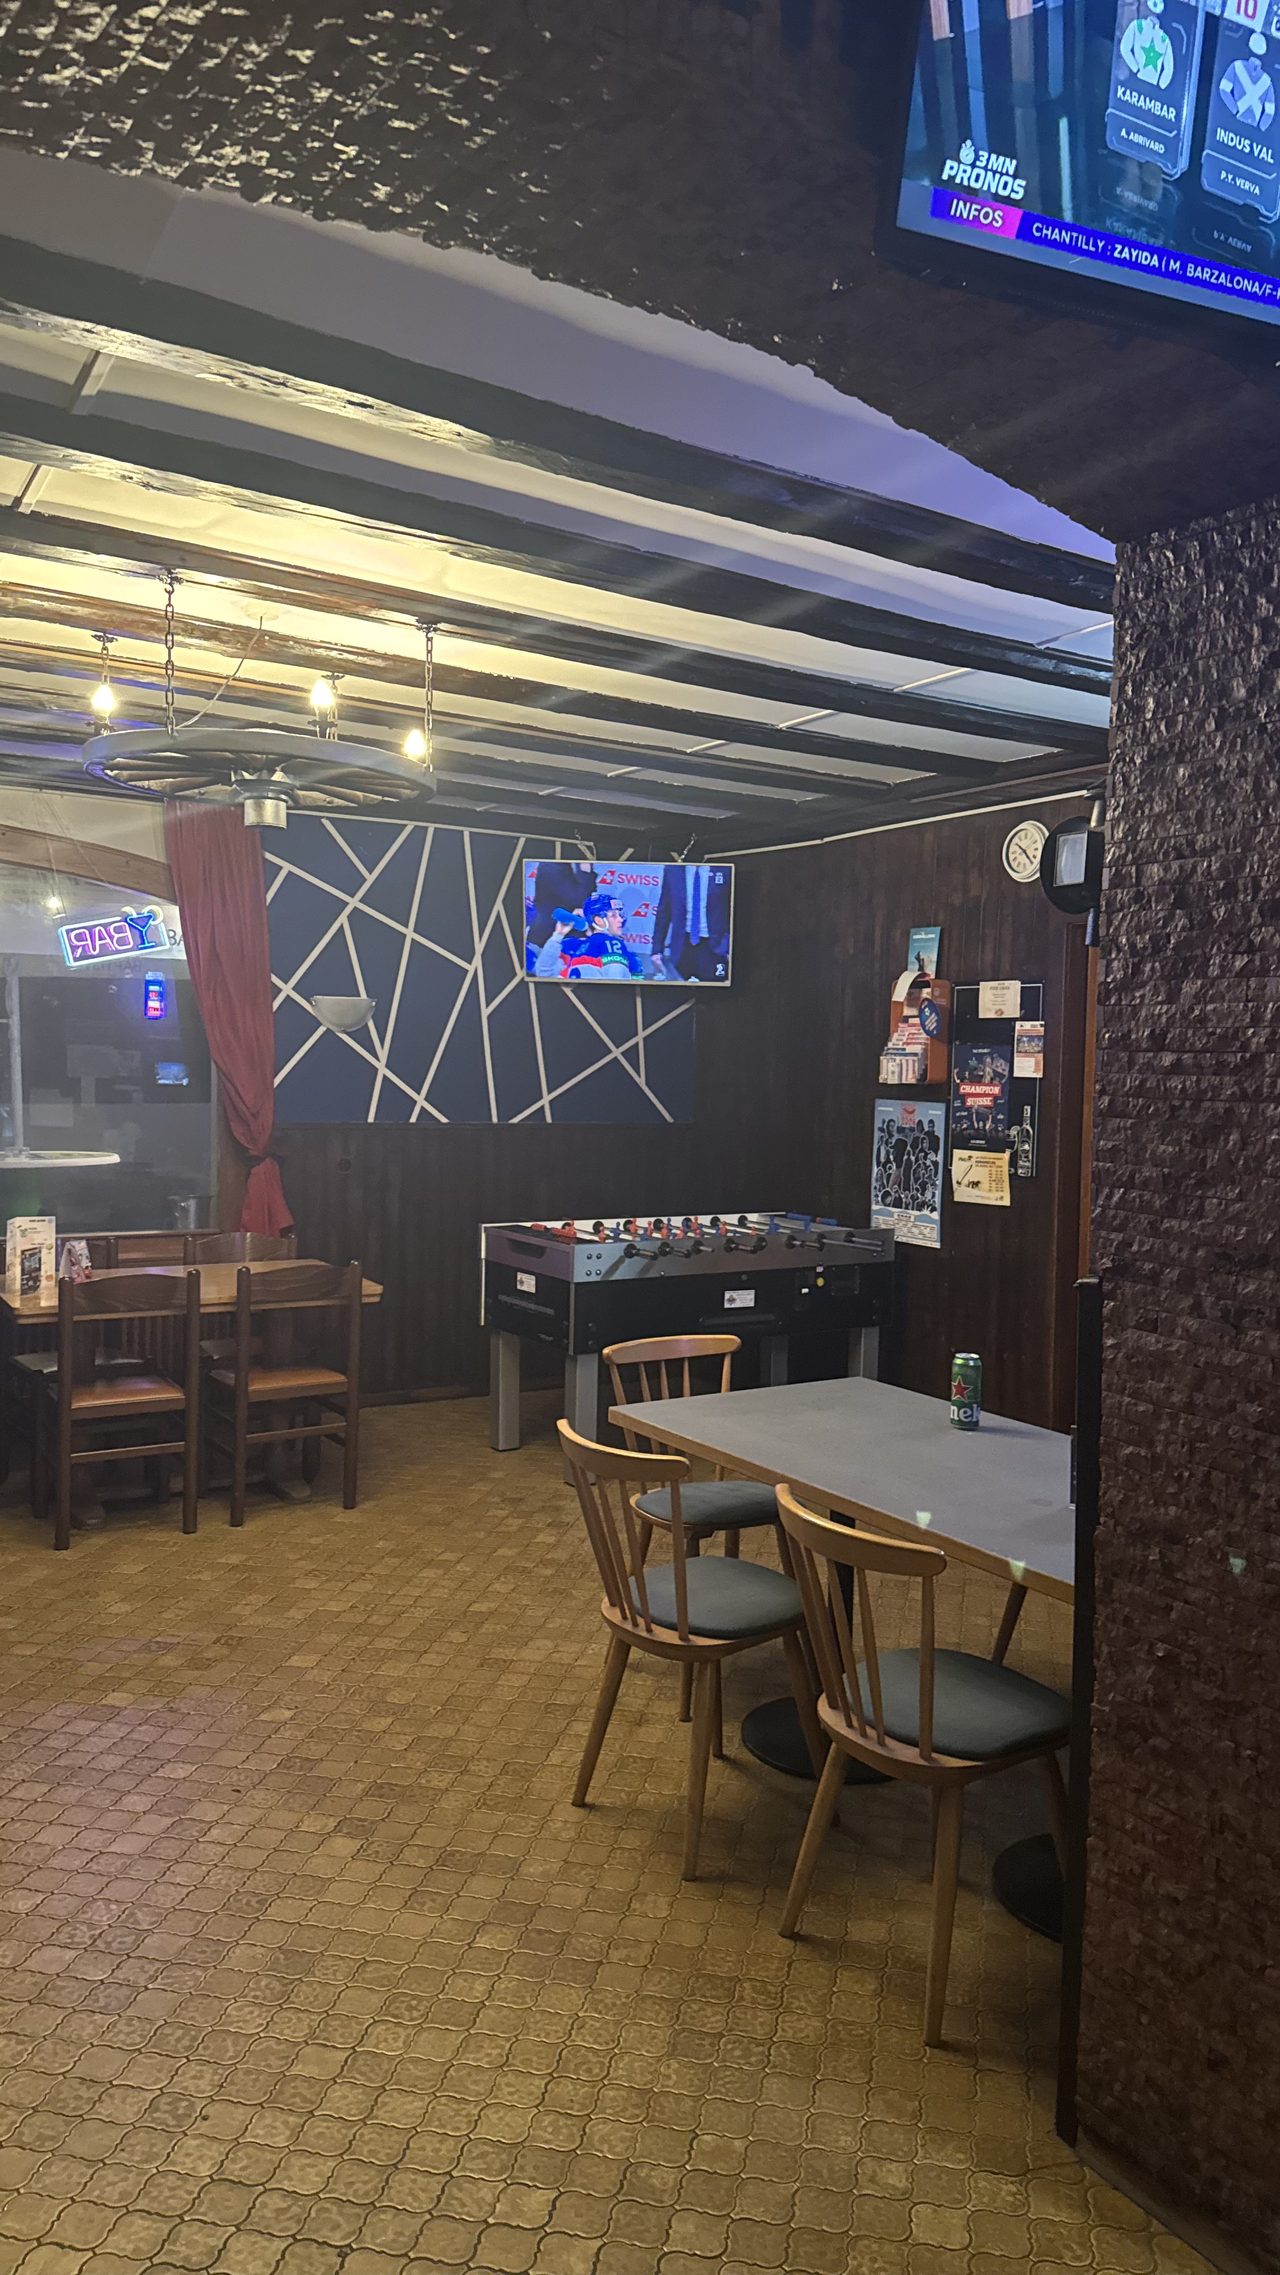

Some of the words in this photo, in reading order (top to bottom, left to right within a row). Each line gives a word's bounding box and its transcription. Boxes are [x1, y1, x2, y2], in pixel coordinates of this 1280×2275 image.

[1117, 85, 1176, 122] KARAMBAR
[1120, 128, 1128, 138] A.
[1216, 127, 1251, 153] INDUS
[1253, 142, 1274, 164] VAL
[975, 150, 989, 168] 3
[987, 153, 1017, 176] MN
[941, 159, 1027, 200] PRONOS
[1236, 177, 1260, 196] VERVA
[950, 198, 1003, 228] INFOS
[1032, 222, 1105, 253] CHANTILLY
[1113, 243, 1159, 268] ZAYIDA
[617, 873, 660, 887] SWISS
[604, 940, 622, 954] 12
[621, 932, 653, 945] WIS
[960, 1085, 1000, 1095] CHAMPION
[966, 1097, 993, 1106] SUISSE
